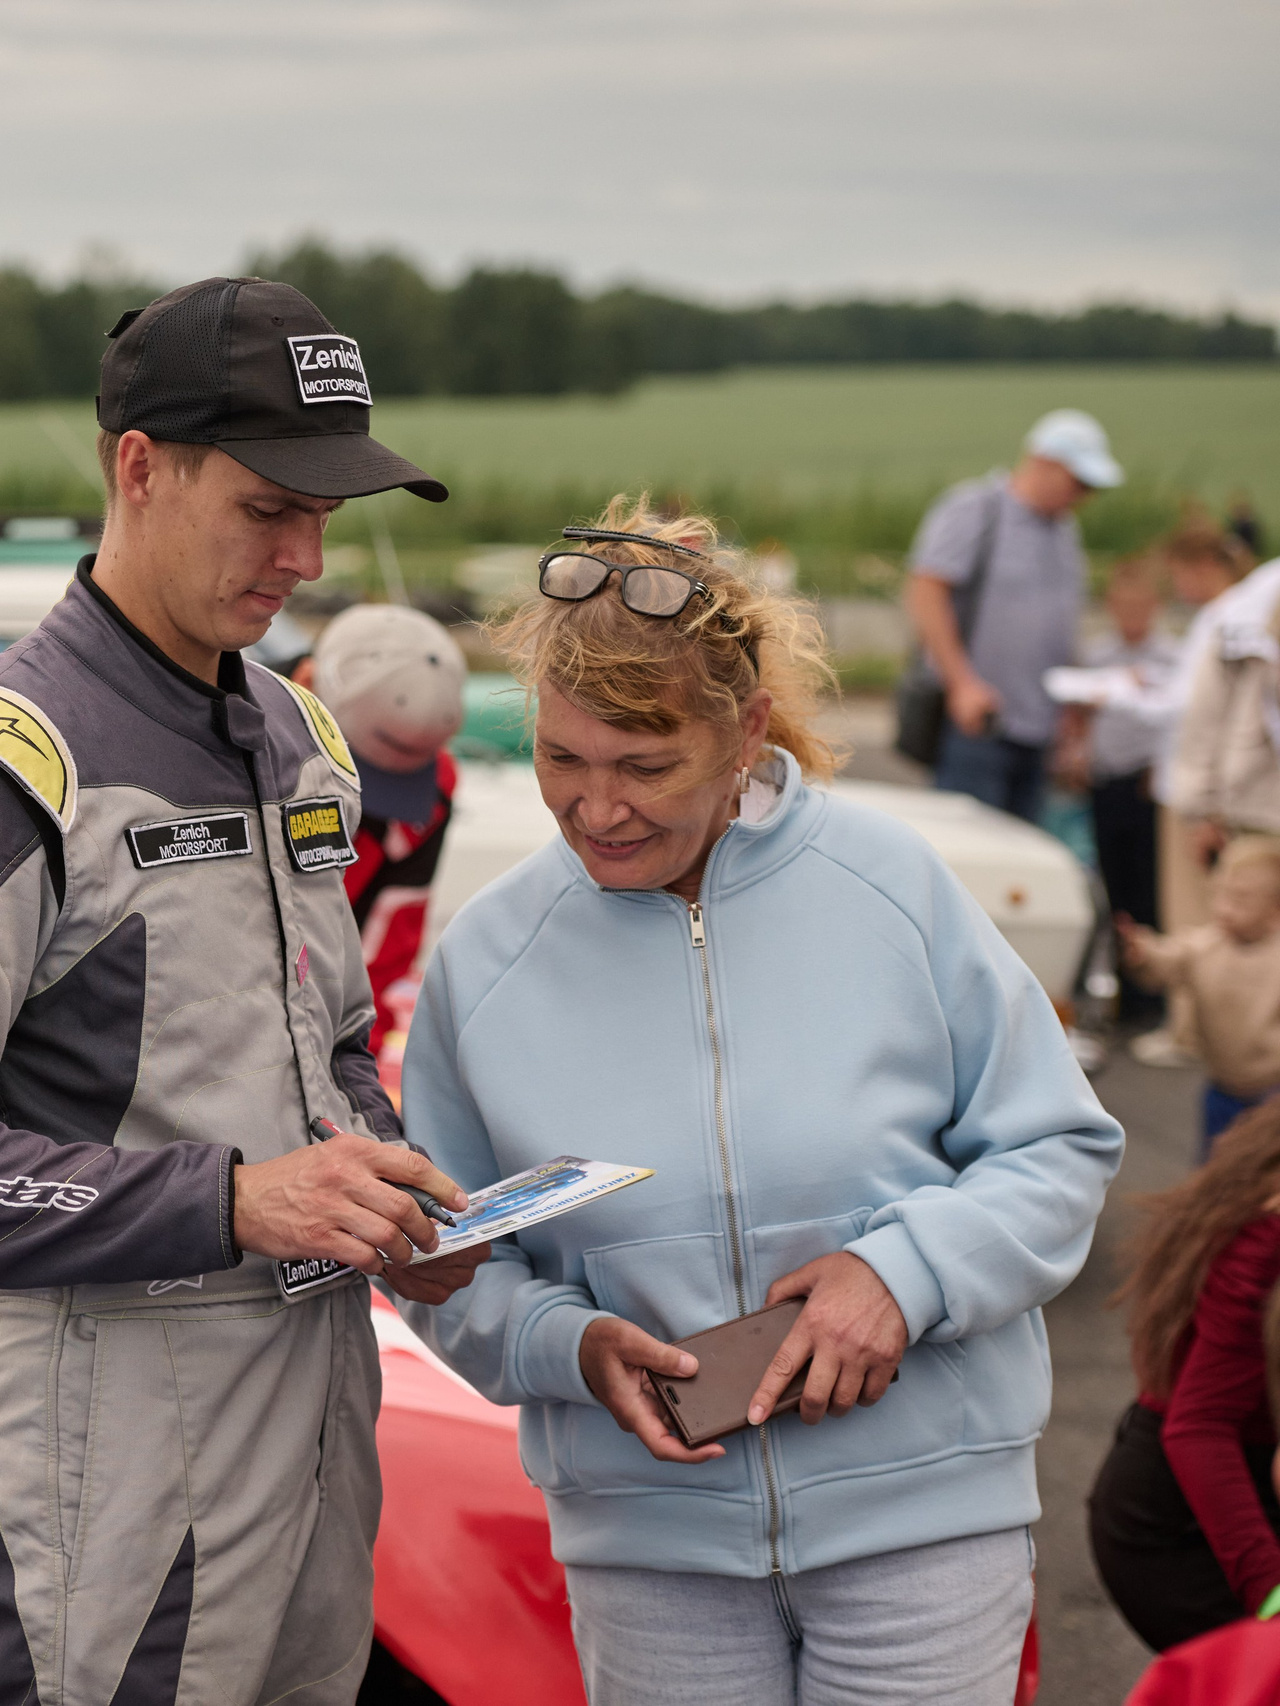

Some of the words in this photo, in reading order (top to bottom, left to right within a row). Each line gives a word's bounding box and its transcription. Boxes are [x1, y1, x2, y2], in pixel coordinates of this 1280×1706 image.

[296, 344, 362, 373] Zenich
[303, 378, 367, 396] MOTORSPORT
[170, 822, 210, 841] Zenich
[159, 837, 228, 860] MOTORSPORT
[282, 1258, 320, 1284] Zenich
